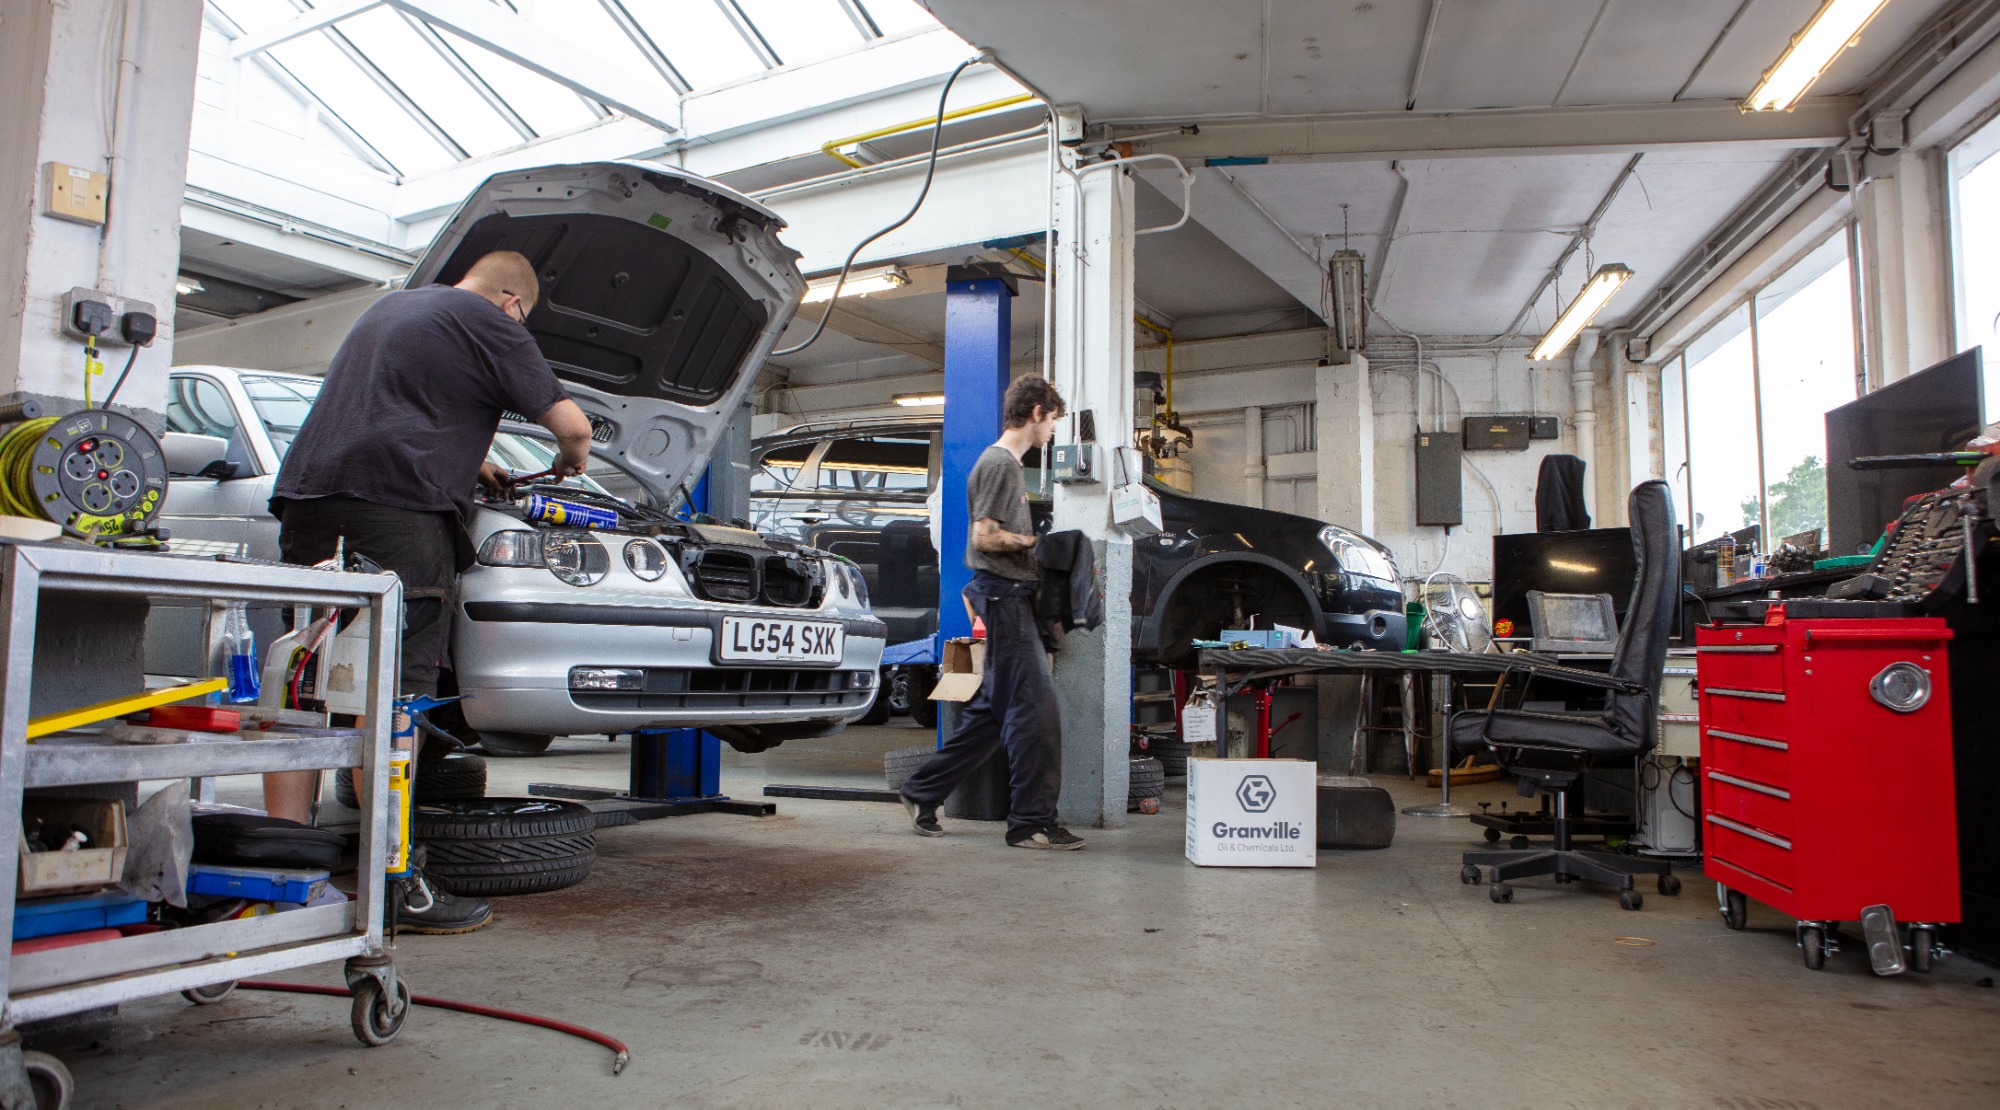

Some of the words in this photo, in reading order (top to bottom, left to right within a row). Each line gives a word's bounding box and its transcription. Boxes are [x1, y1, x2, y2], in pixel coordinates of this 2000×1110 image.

[733, 621, 795, 654] LG54
[801, 625, 836, 655] SXK
[1212, 821, 1300, 839] Granville
[1217, 842, 1229, 852] Oil
[1229, 842, 1236, 852] &
[1237, 842, 1279, 853] Chemicals
[1280, 843, 1297, 853] Ltd.
